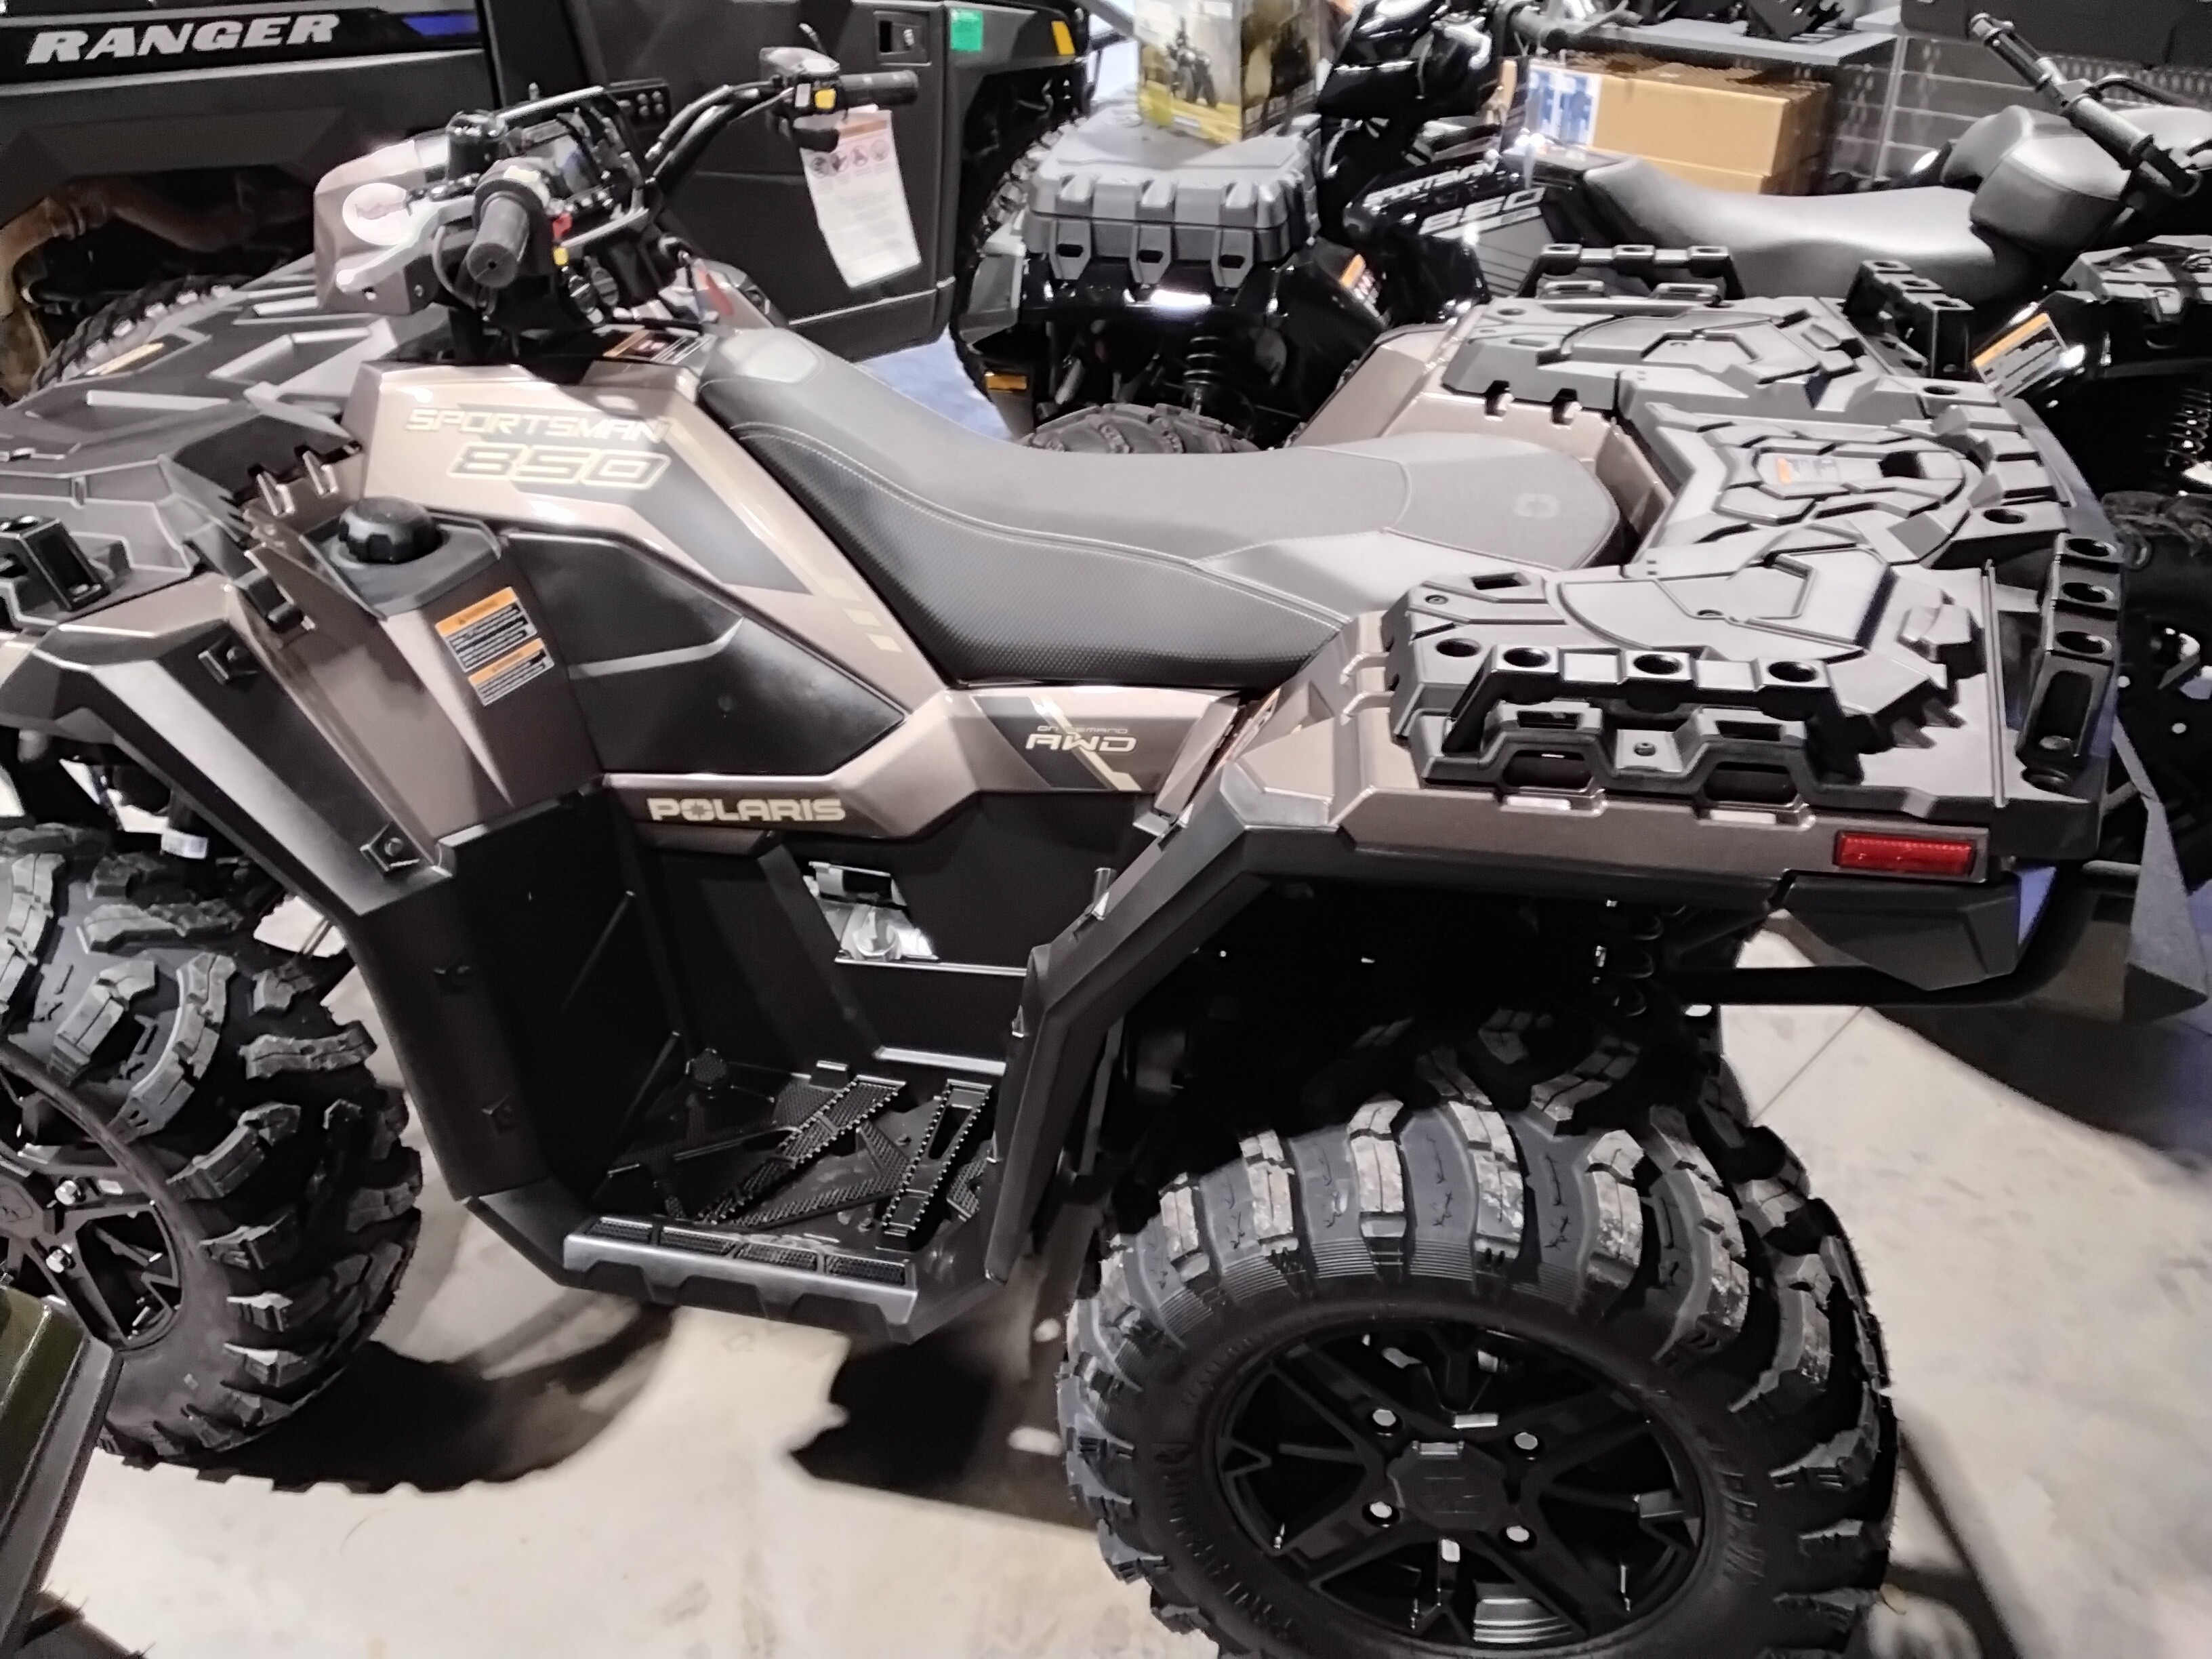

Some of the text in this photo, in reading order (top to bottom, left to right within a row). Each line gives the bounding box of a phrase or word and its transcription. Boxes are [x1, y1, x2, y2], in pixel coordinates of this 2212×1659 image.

[26, 14, 340, 65] RANGER
[1418, 186, 1546, 235] 850
[405, 407, 670, 443] SPORTSMAN
[447, 441, 671, 491] 850
[1025, 733, 1137, 752] AWD
[646, 798, 846, 821] POLARIS
